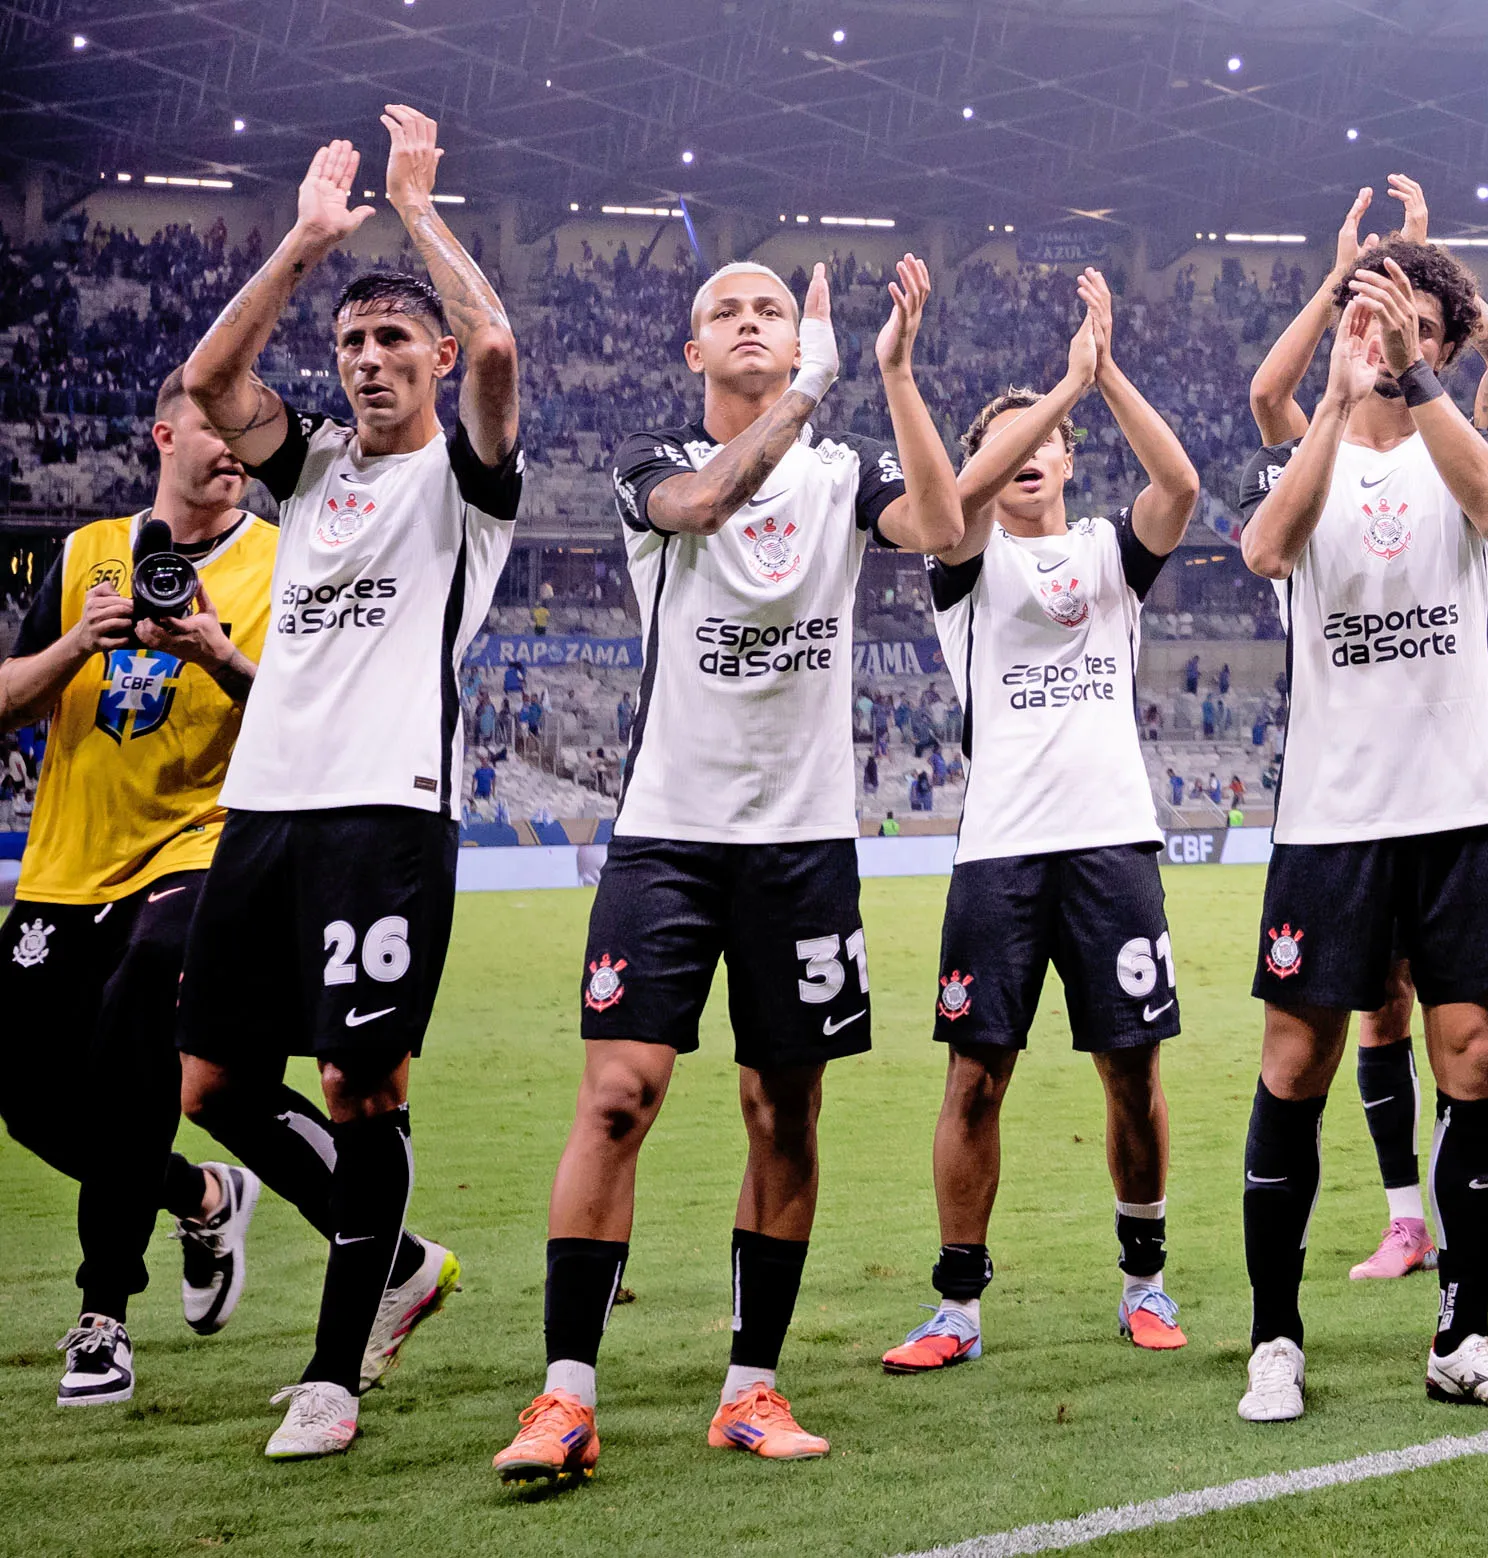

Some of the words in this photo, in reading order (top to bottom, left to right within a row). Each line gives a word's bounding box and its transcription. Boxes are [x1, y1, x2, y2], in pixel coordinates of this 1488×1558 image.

[301, 603, 386, 634] Sorte
[695, 616, 840, 654] Esportes
[1323, 603, 1459, 642] Esportes
[121, 675, 155, 691] CBF
[1001, 653, 1117, 689] Espotes
[1167, 833, 1213, 863] CBF
[323, 915, 412, 987] 26
[796, 928, 870, 1004] 31
[1117, 930, 1176, 997] 61
